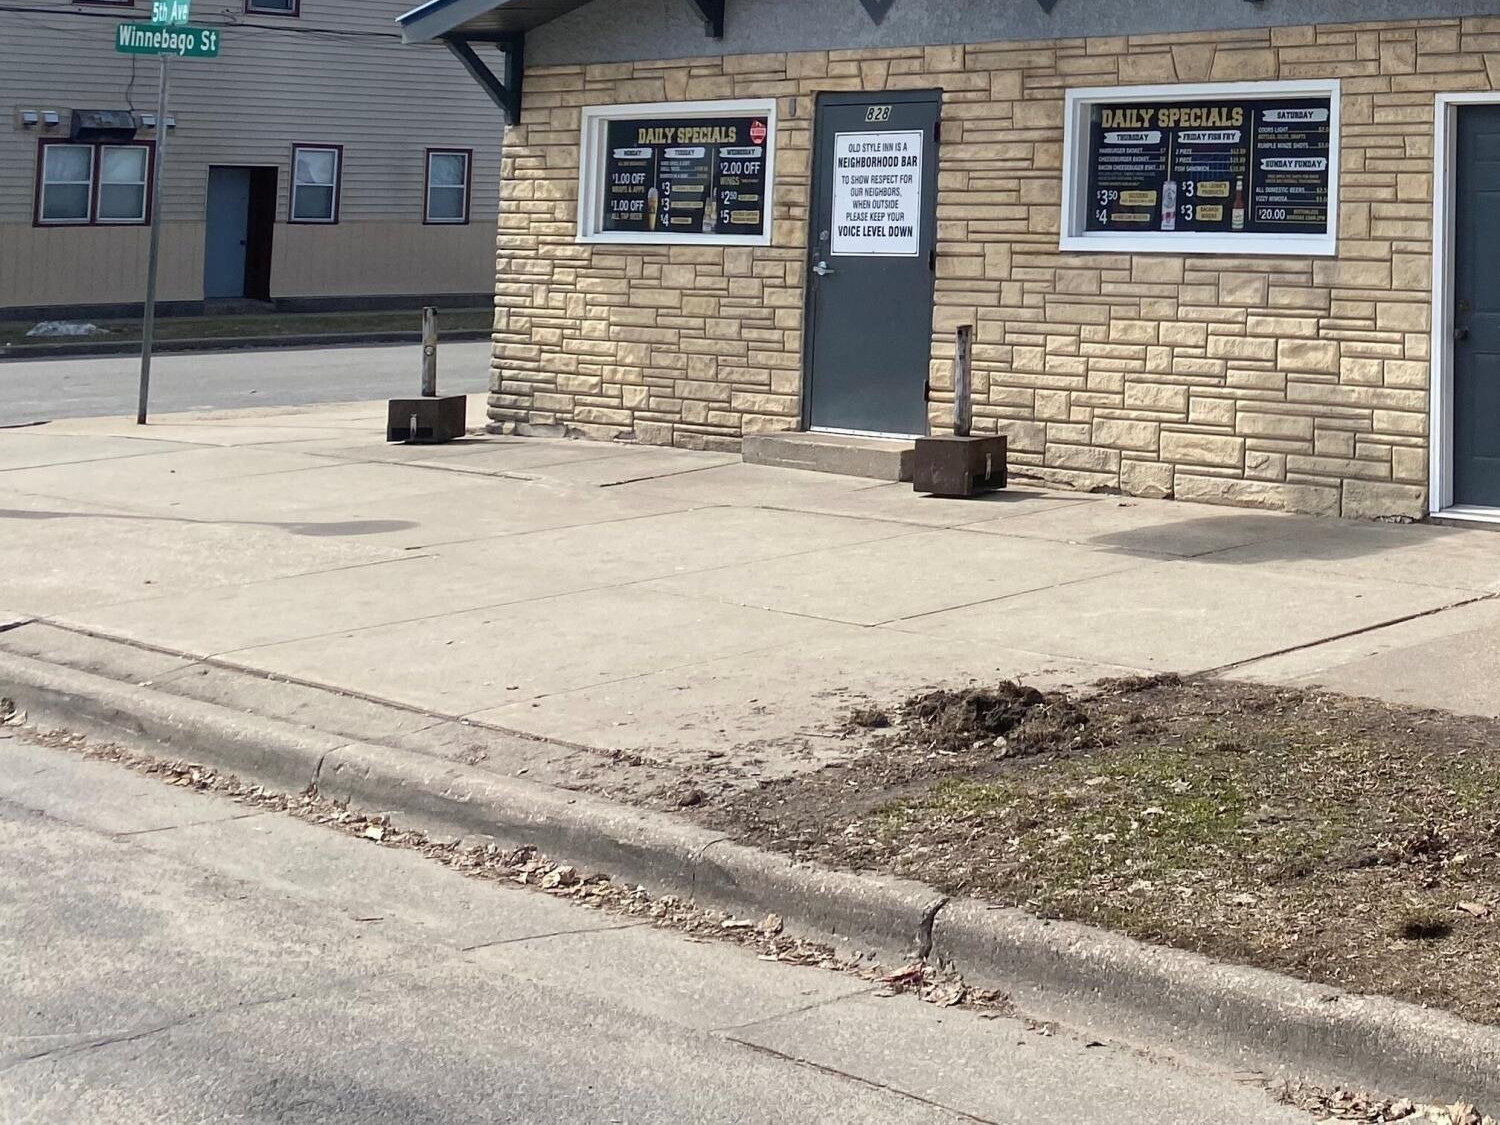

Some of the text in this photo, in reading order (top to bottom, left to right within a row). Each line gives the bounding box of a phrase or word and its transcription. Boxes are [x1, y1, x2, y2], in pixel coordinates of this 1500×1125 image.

[152, 0, 188, 22] 5th Ave
[119, 24, 217, 55] Winnebago St
[867, 107, 889, 121] 828
[1102, 106, 1243, 128] DAILY SPECIALS
[1277, 111, 1314, 119] SATURDAY
[638, 126, 736, 144] DAILY SPECIALS
[1182, 133, 1207, 141] FRIDAY
[1222, 132, 1237, 141] FRY
[848, 142, 908, 153] OLD STYLE INN IS A
[838, 155, 918, 168] NEIGHBORHOOD BAR
[1265, 160, 1322, 168] SUNDAY FUNDAY
[720, 162, 742, 174] $2.00
[743, 162, 760, 174] OFF
[631, 173, 646, 184] OFF
[842, 174, 913, 184] TO SHOW RESPECT FOR
[661, 182, 670, 195] $3
[850, 187, 902, 197] OUR NEIGHBORS,
[1182, 181, 1194, 197] $3
[630, 200, 644, 211] OFF
[661, 198, 670, 211] $3
[852, 199, 899, 209] WHEN OUTSIDE
[720, 210, 730, 224] $5
[846, 211, 905, 221] PLEASE KEEP YOUR
[1096, 209, 1107, 225] $4
[1180, 204, 1193, 221] $3
[1259, 209, 1286, 220] $20.00
[660, 213, 669, 227] $4
[838, 225, 913, 237] VOICE LEVEL DOWN
